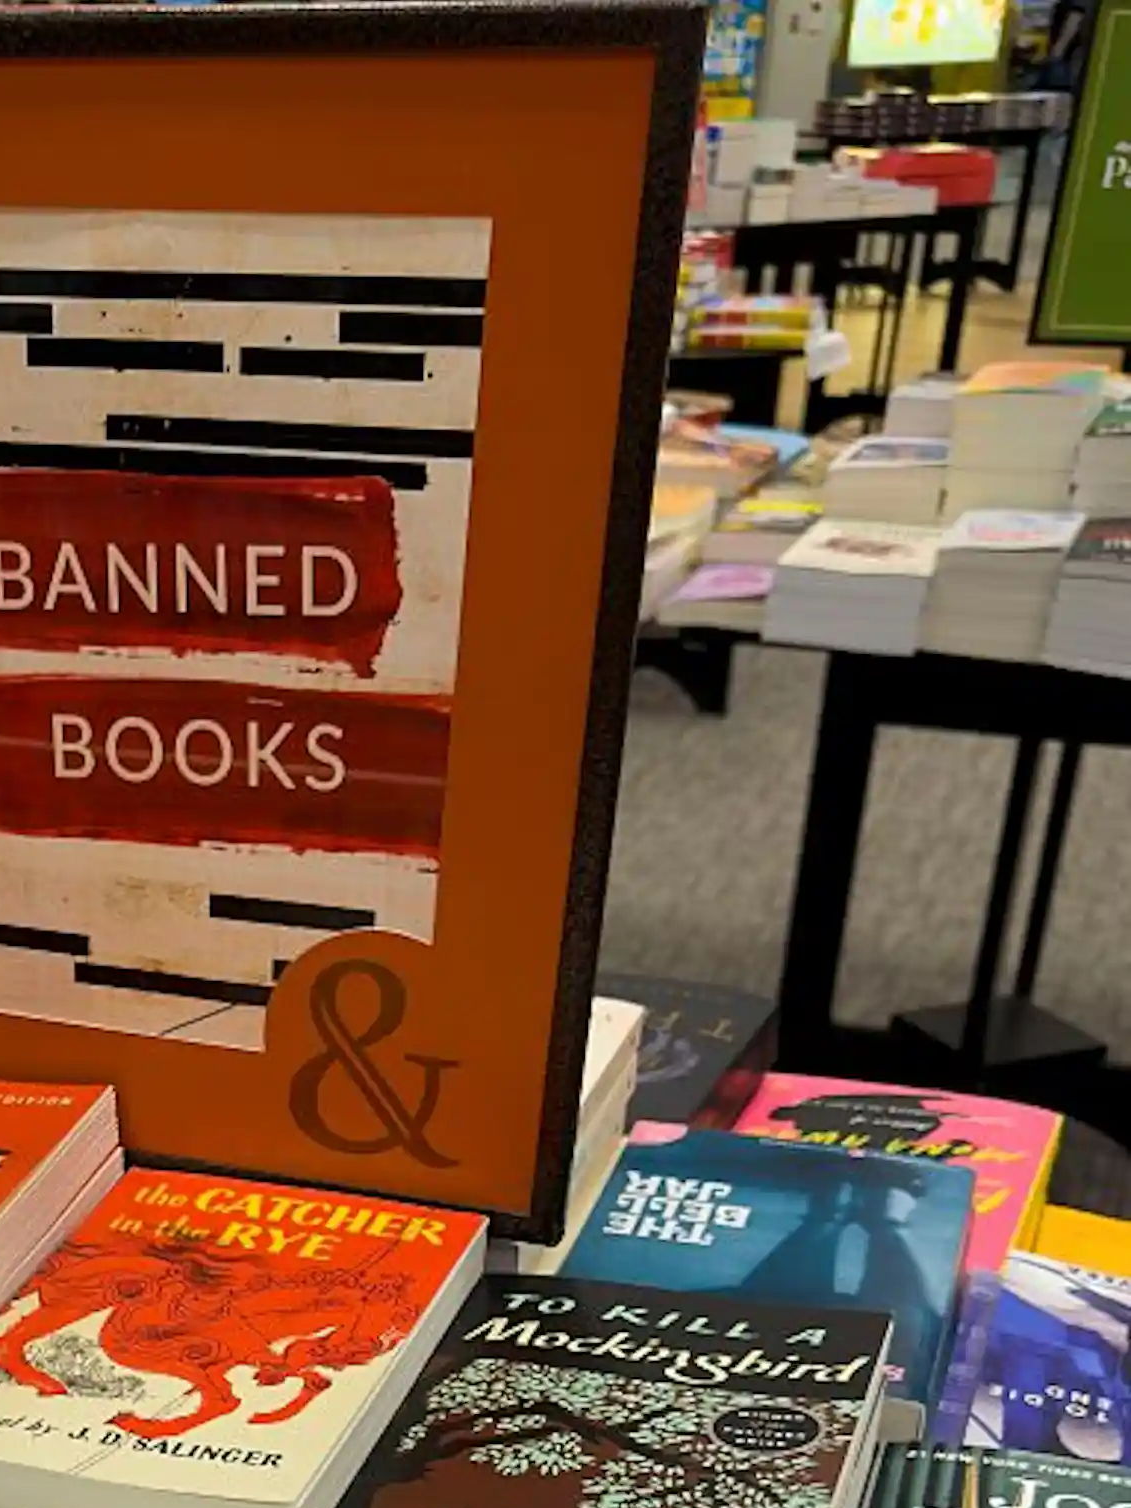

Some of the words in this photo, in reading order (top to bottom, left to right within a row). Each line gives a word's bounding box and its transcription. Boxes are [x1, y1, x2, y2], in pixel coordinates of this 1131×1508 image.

[50, 712, 347, 791] BOOKS
[623, 1168, 734, 1204] JAR
[134, 1183, 189, 1207] the
[194, 1186, 449, 1247] CATCHER
[600, 1212, 717, 1247] THE
[614, 1191, 754, 1230] BELL
[216, 1221, 343, 1263] RYE
[499, 1292, 573, 1316] TO
[600, 1303, 761, 1342] KILL
[784, 1325, 829, 1346] A
[462, 1315, 871, 1386] Mockingbird
[27, 1422, 60, 1438] by
[67, 1427, 91, 1444] J.
[99, 1431, 124, 1449] D.
[130, 1436, 284, 1470] SALINGER
